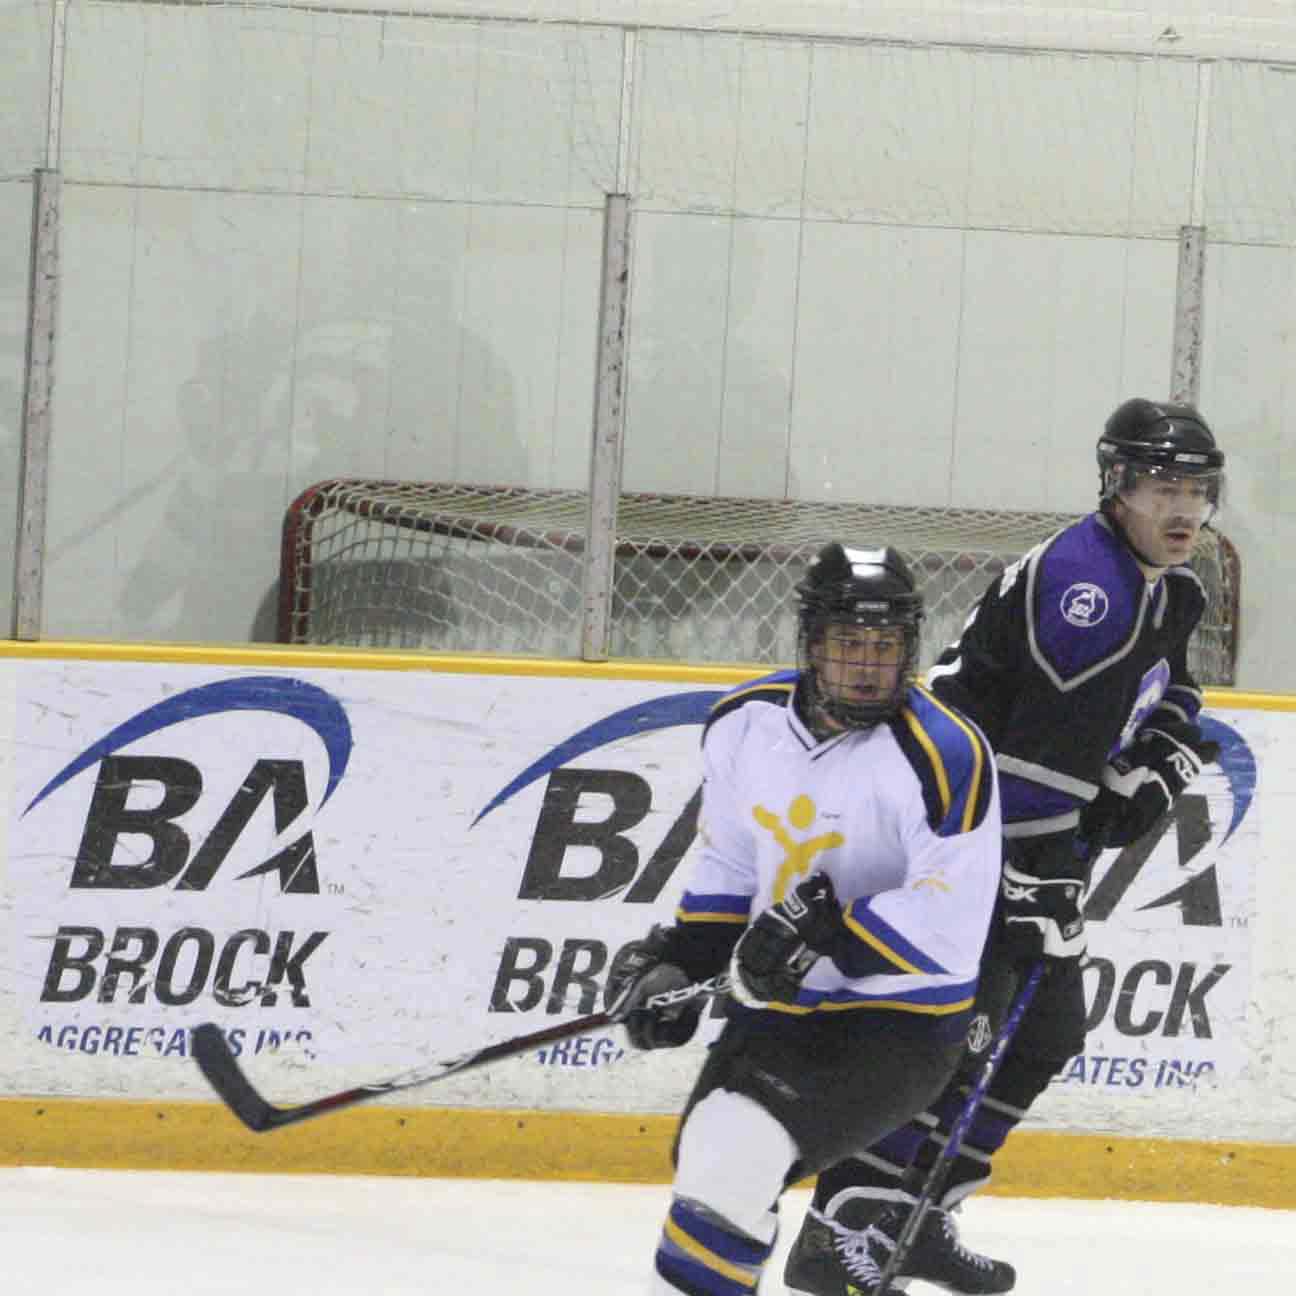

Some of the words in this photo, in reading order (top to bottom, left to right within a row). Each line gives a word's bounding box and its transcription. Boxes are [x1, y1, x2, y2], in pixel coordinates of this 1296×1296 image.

[1083, 794, 1223, 928] A
[40, 925, 330, 1009] BROCK
[1082, 957, 1233, 1040] OCK
[37, 1024, 244, 1058] AGGREGAS
